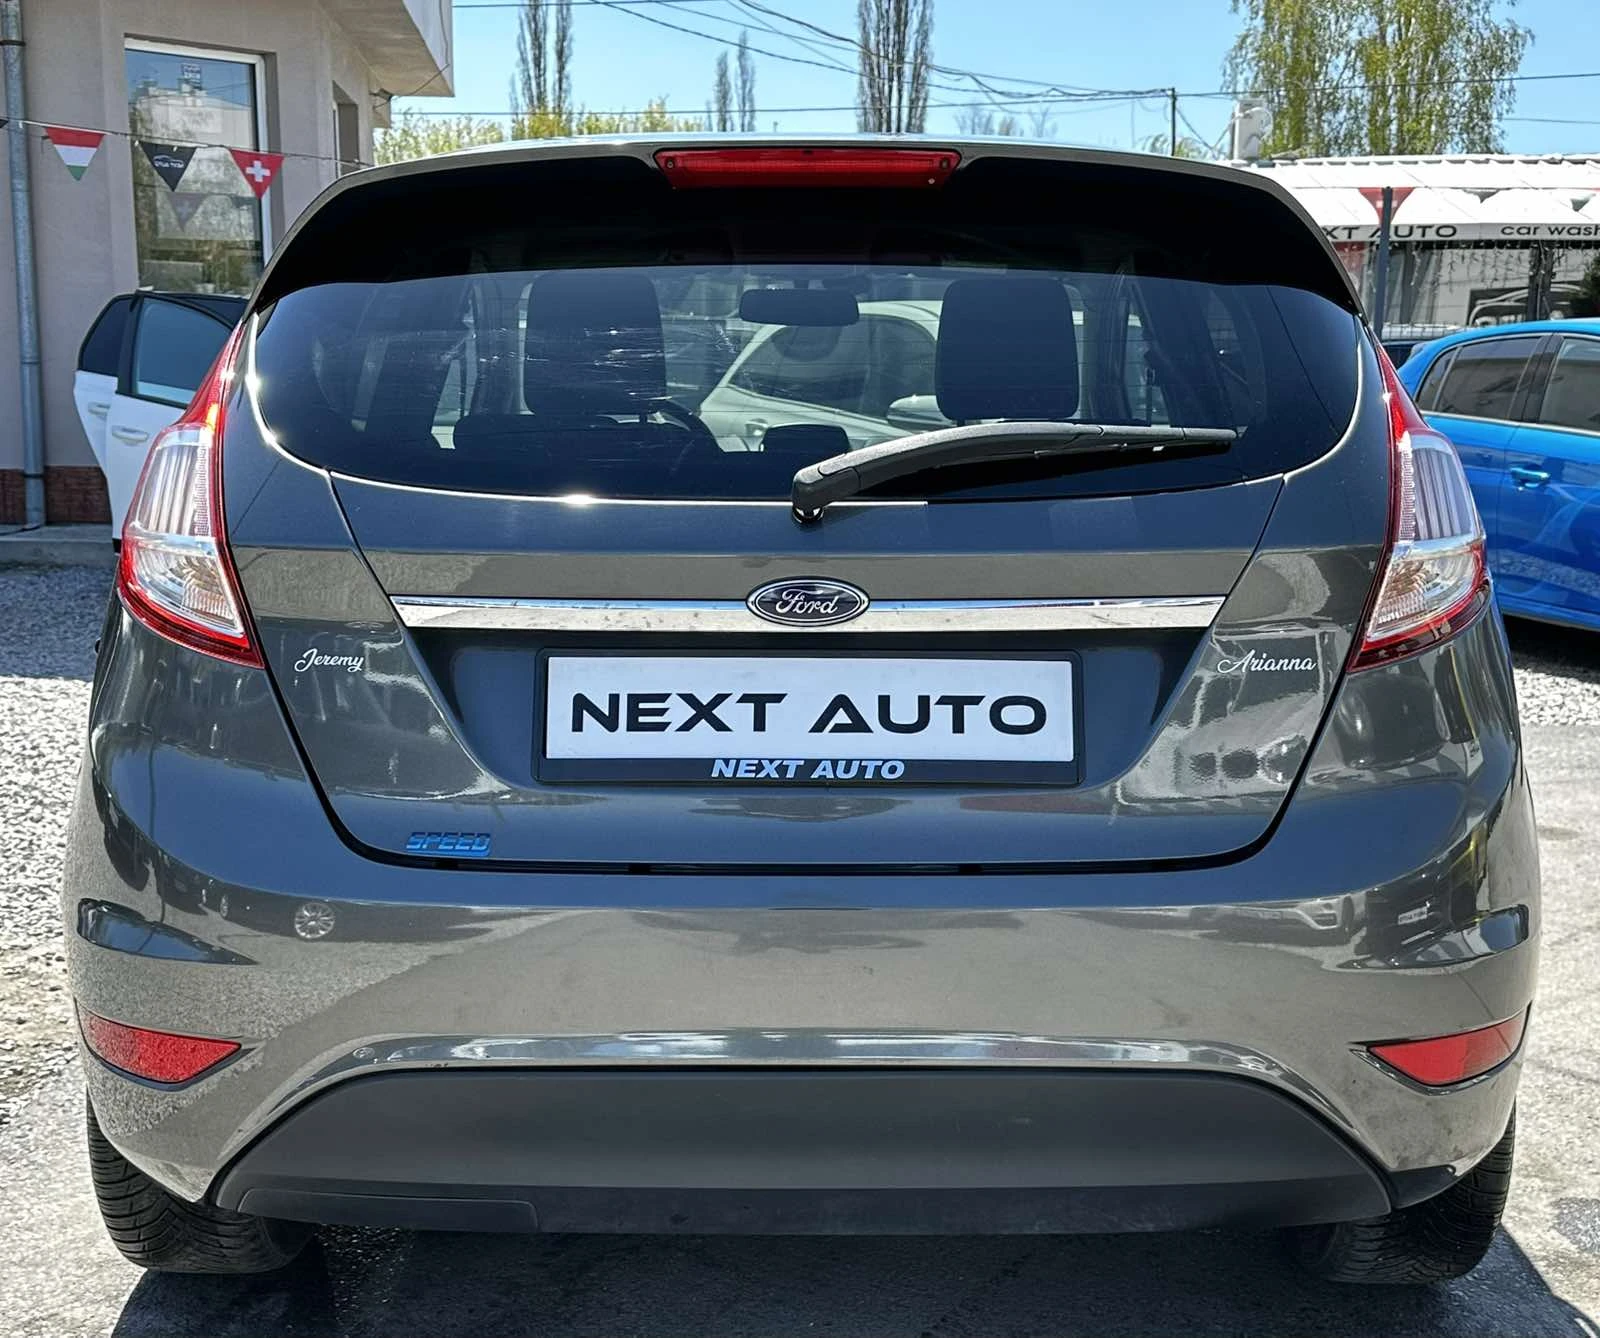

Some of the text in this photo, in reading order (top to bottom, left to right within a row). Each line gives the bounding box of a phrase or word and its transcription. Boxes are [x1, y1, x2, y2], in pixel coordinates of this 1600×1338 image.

[1500, 226, 1540, 236] car
[775, 588, 840, 614] Ford
[294, 647, 364, 673] Jeremy
[1217, 649, 1317, 674] Arianna
[571, 692, 1047, 736] NEXT AUTO
[711, 759, 905, 779] NEXT AUTO
[406, 832, 491, 853] SPEED
